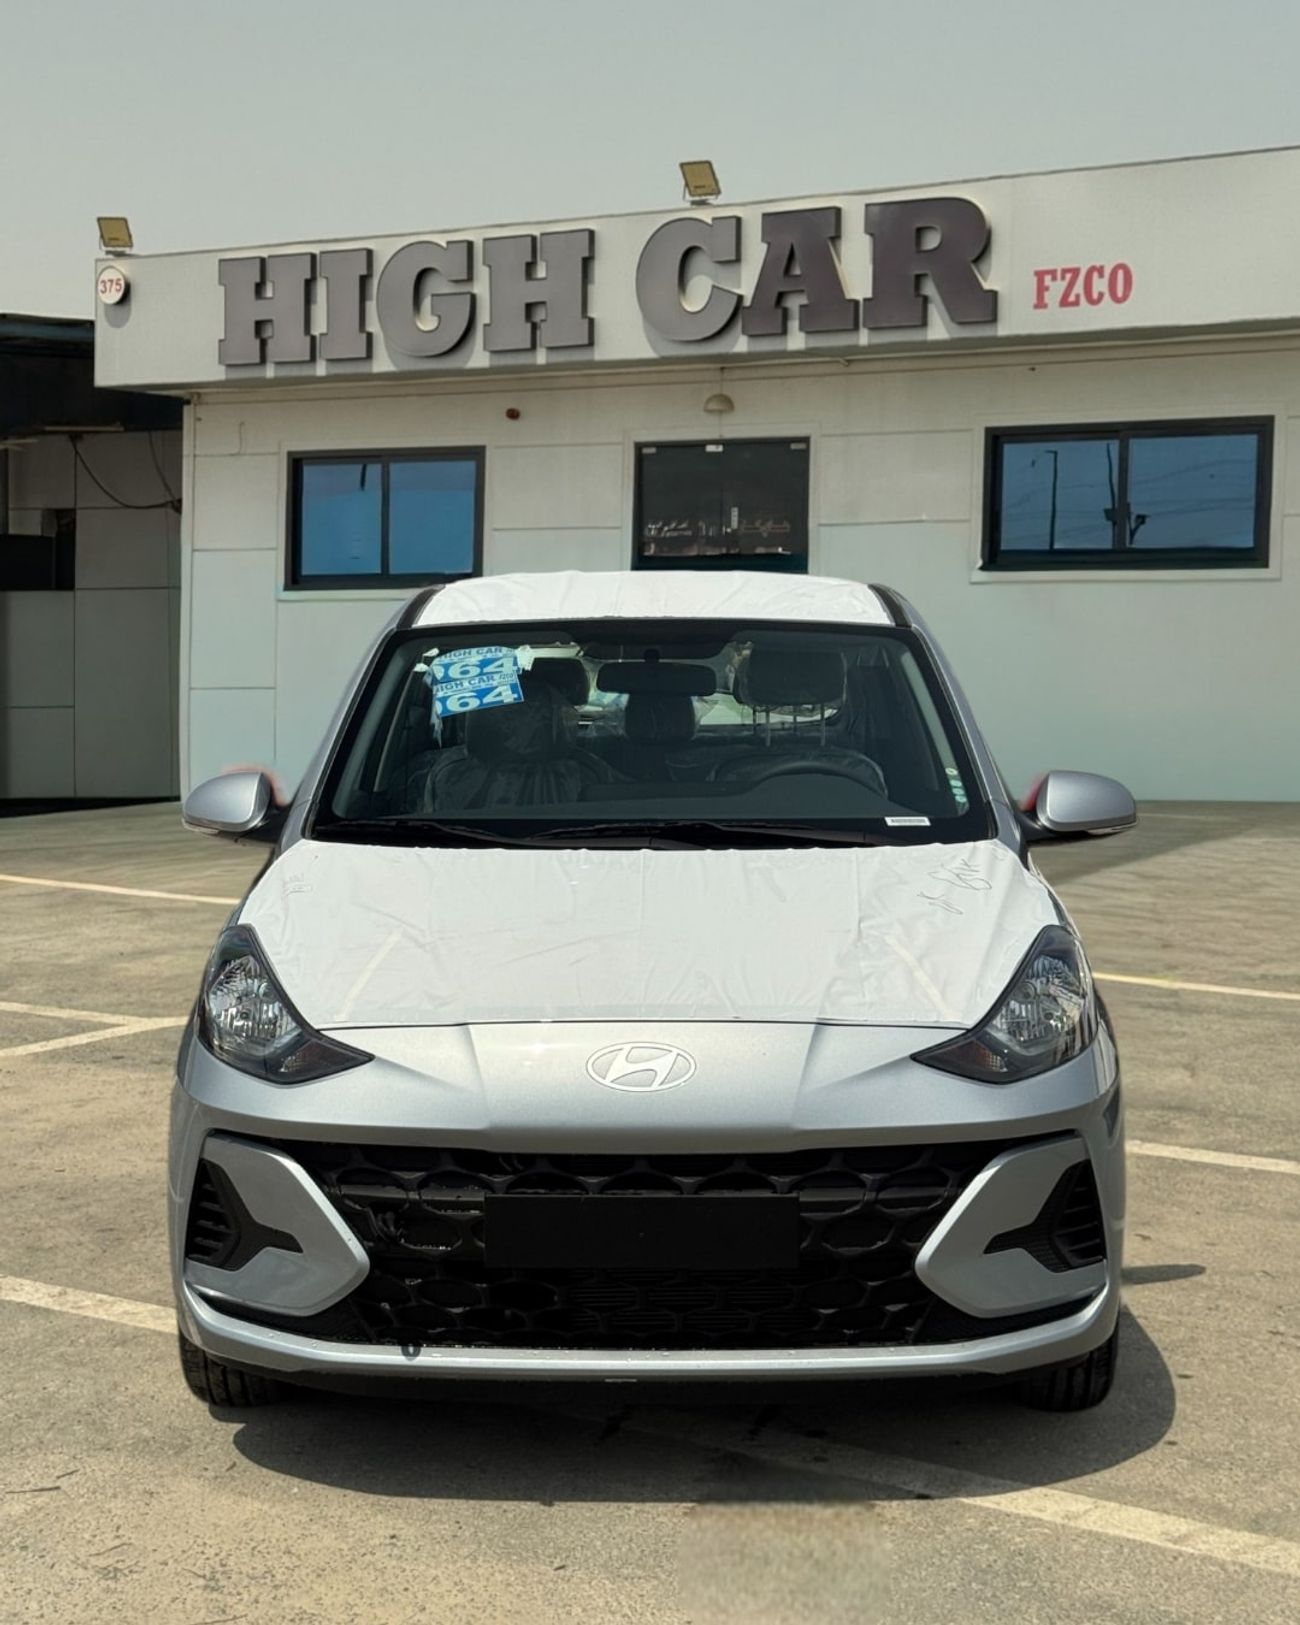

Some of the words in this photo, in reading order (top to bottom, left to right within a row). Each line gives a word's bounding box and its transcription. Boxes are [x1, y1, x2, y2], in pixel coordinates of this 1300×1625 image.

[100, 278, 122, 294] 375
[219, 229, 595, 365] HIGH
[636, 197, 998, 342] CAR
[1033, 263, 1133, 310] FZCO
[468, 675, 495, 685] CAR
[435, 685, 518, 713] 64
